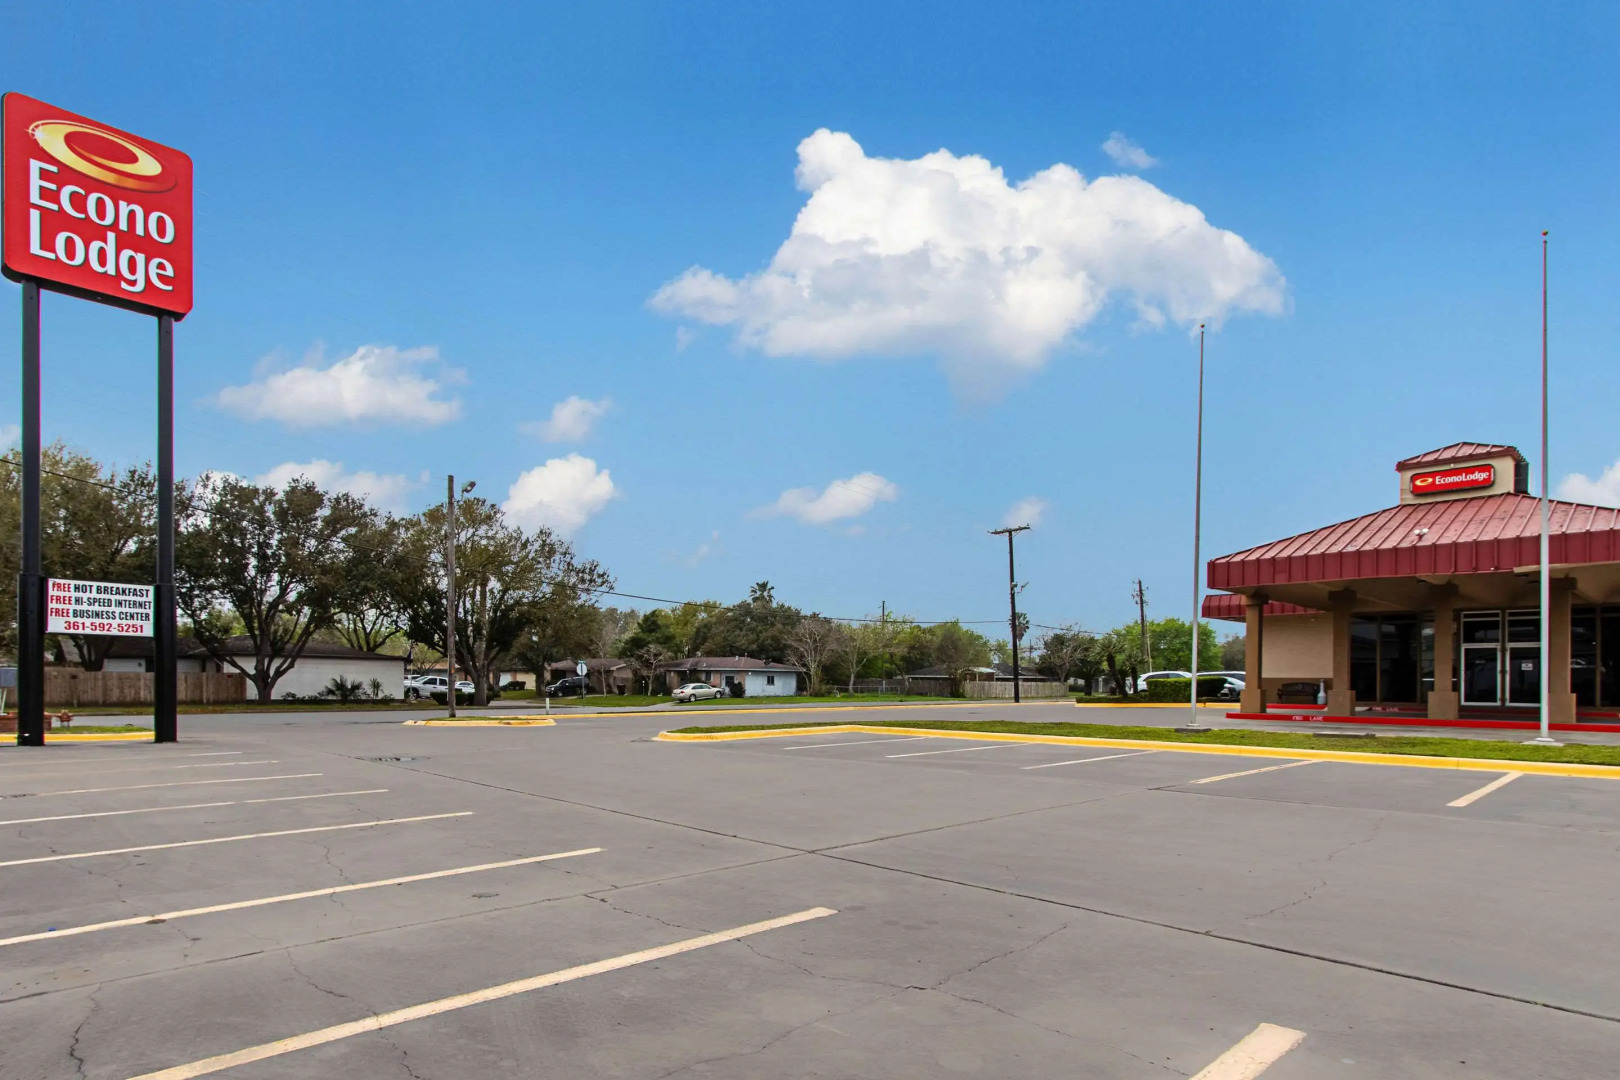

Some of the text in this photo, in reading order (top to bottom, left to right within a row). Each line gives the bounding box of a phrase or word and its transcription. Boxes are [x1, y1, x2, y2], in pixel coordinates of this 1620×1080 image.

[29, 158, 175, 244] Econo
[29, 207, 175, 292] Lodge
[1435, 471, 1489, 485] EconoLodge
[52, 582, 150, 598] FREE HOT BREAKFAST
[50, 595, 152, 610] FREE HI-SPEED INTERNET
[50, 607, 151, 622] FREE BUSINESS CENTER
[64, 620, 144, 634] 361-592-5251
